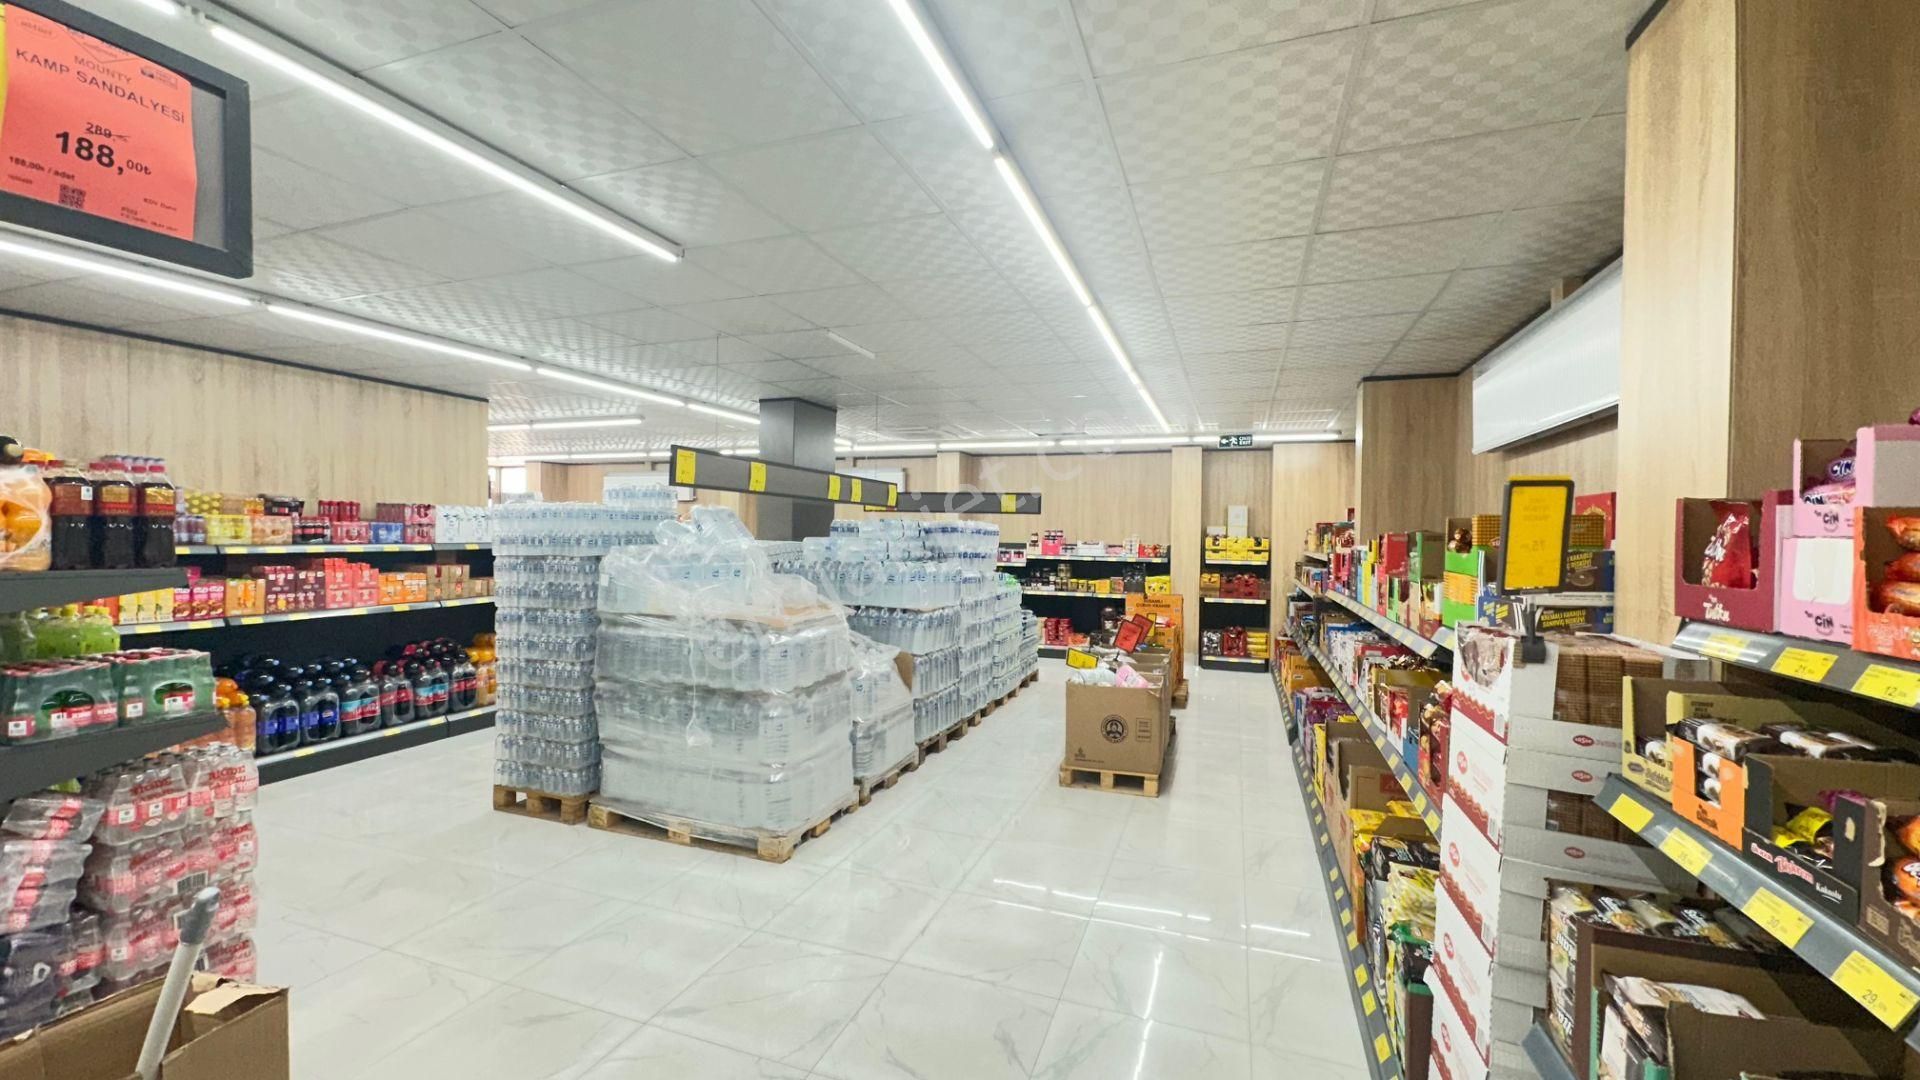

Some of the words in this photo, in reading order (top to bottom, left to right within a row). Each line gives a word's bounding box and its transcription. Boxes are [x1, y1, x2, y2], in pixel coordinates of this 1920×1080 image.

[16, 48, 70, 75] KAMP
[76, 70, 186, 124] SANDALYESİ
[73, 55, 132, 84] MOUNTY
